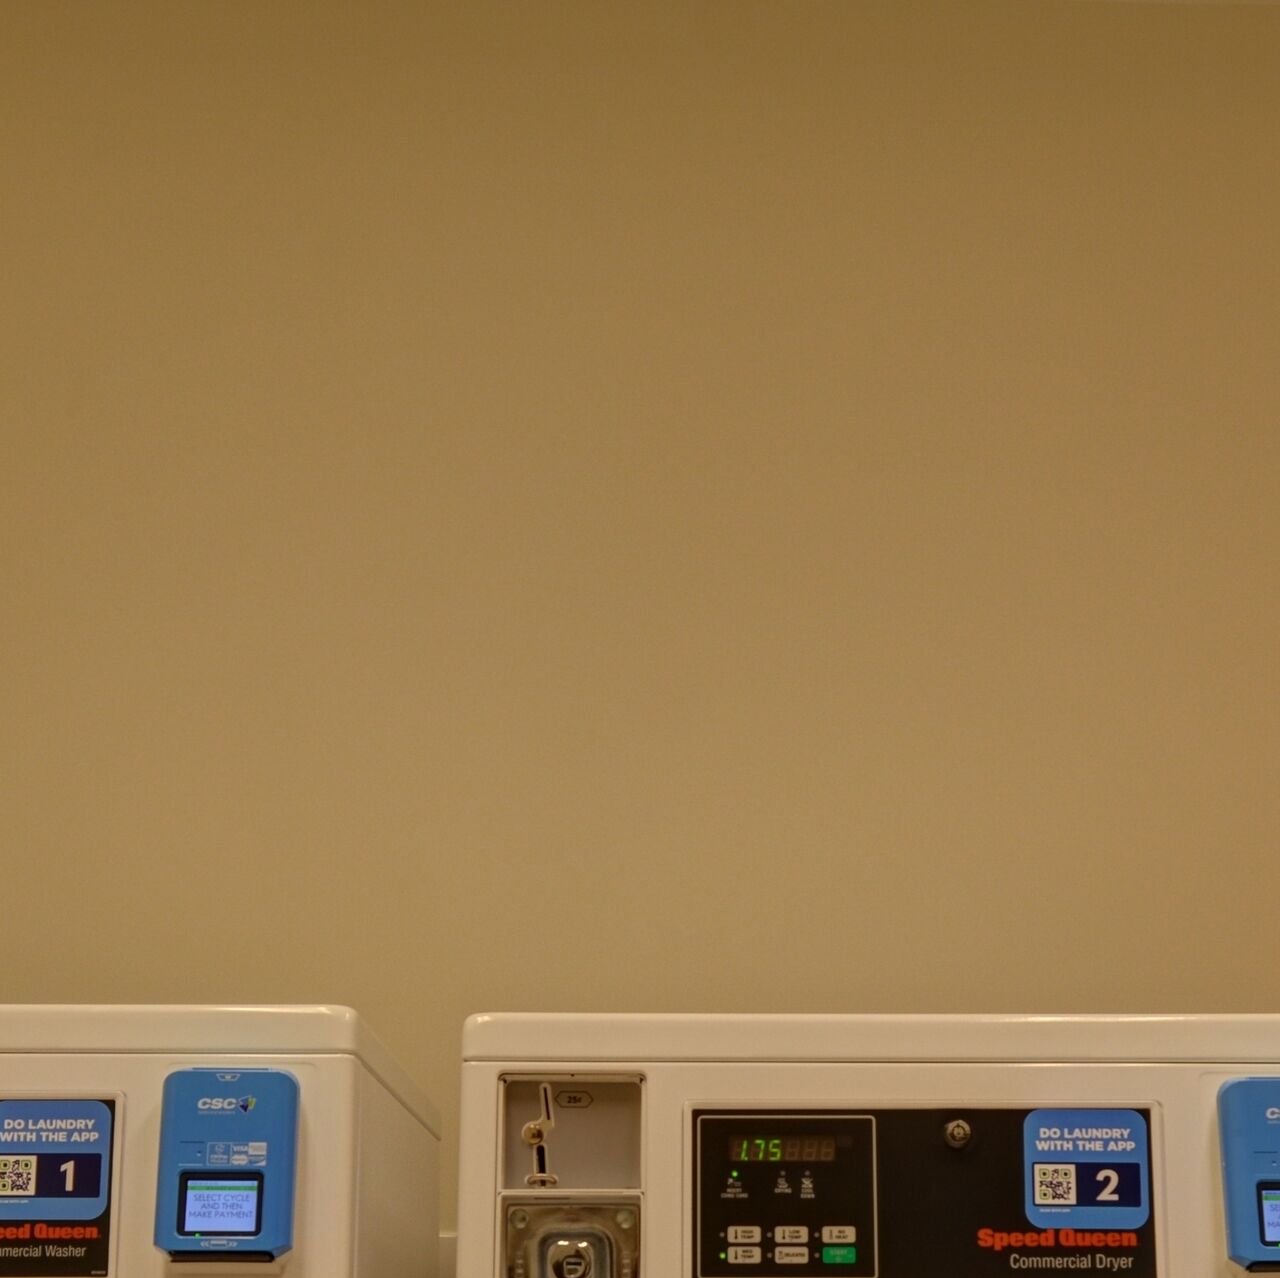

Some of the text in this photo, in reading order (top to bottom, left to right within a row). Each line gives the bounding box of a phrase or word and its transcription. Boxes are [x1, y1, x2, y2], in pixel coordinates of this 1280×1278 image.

[197, 1097, 237, 1111] CSC
[3, 1119, 95, 1130] DO LAUNDRY
[0, 1131, 100, 1143] WITH THE APP
[1039, 1128, 1131, 1139] DO LAUNDRY
[740, 1139, 782, 1161] 1.75
[1035, 1140, 1136, 1151] WITH THE APP
[59, 1160, 75, 1192] 1
[1095, 1169, 1120, 1201] 2
[193, 1194, 250, 1203] SELECT CYCLE
[200, 1203, 243, 1211] AND THEN
[188, 1211, 254, 1219] MAKE PAYMENT
[33, 1222, 99, 1240] Queen
[977, 1228, 1138, 1251] Speed Queen
[45, 1244, 87, 1258] Washer
[1009, 1254, 1134, 1271] Commercial Dryer
